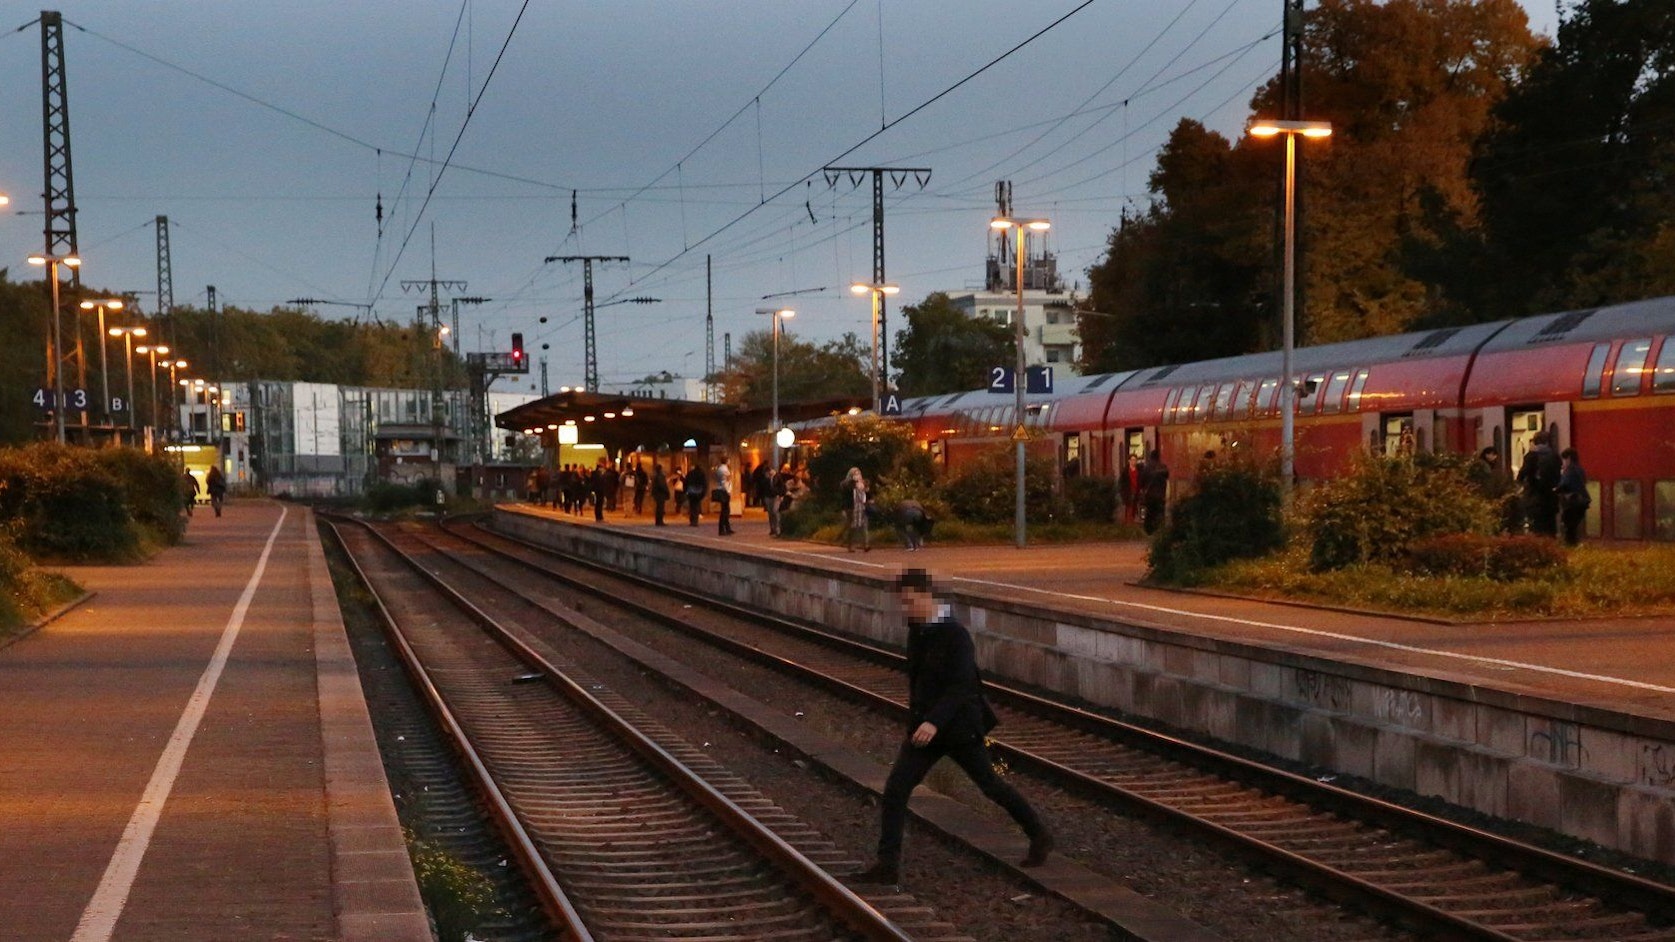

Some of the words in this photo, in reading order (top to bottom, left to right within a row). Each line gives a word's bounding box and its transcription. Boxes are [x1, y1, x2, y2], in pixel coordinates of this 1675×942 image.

[992, 367, 1005, 388] 2
[1041, 368, 1050, 388] 1
[33, 388, 45, 407] 4
[74, 389, 86, 407] 3
[112, 397, 122, 411] B
[886, 395, 899, 411] A
